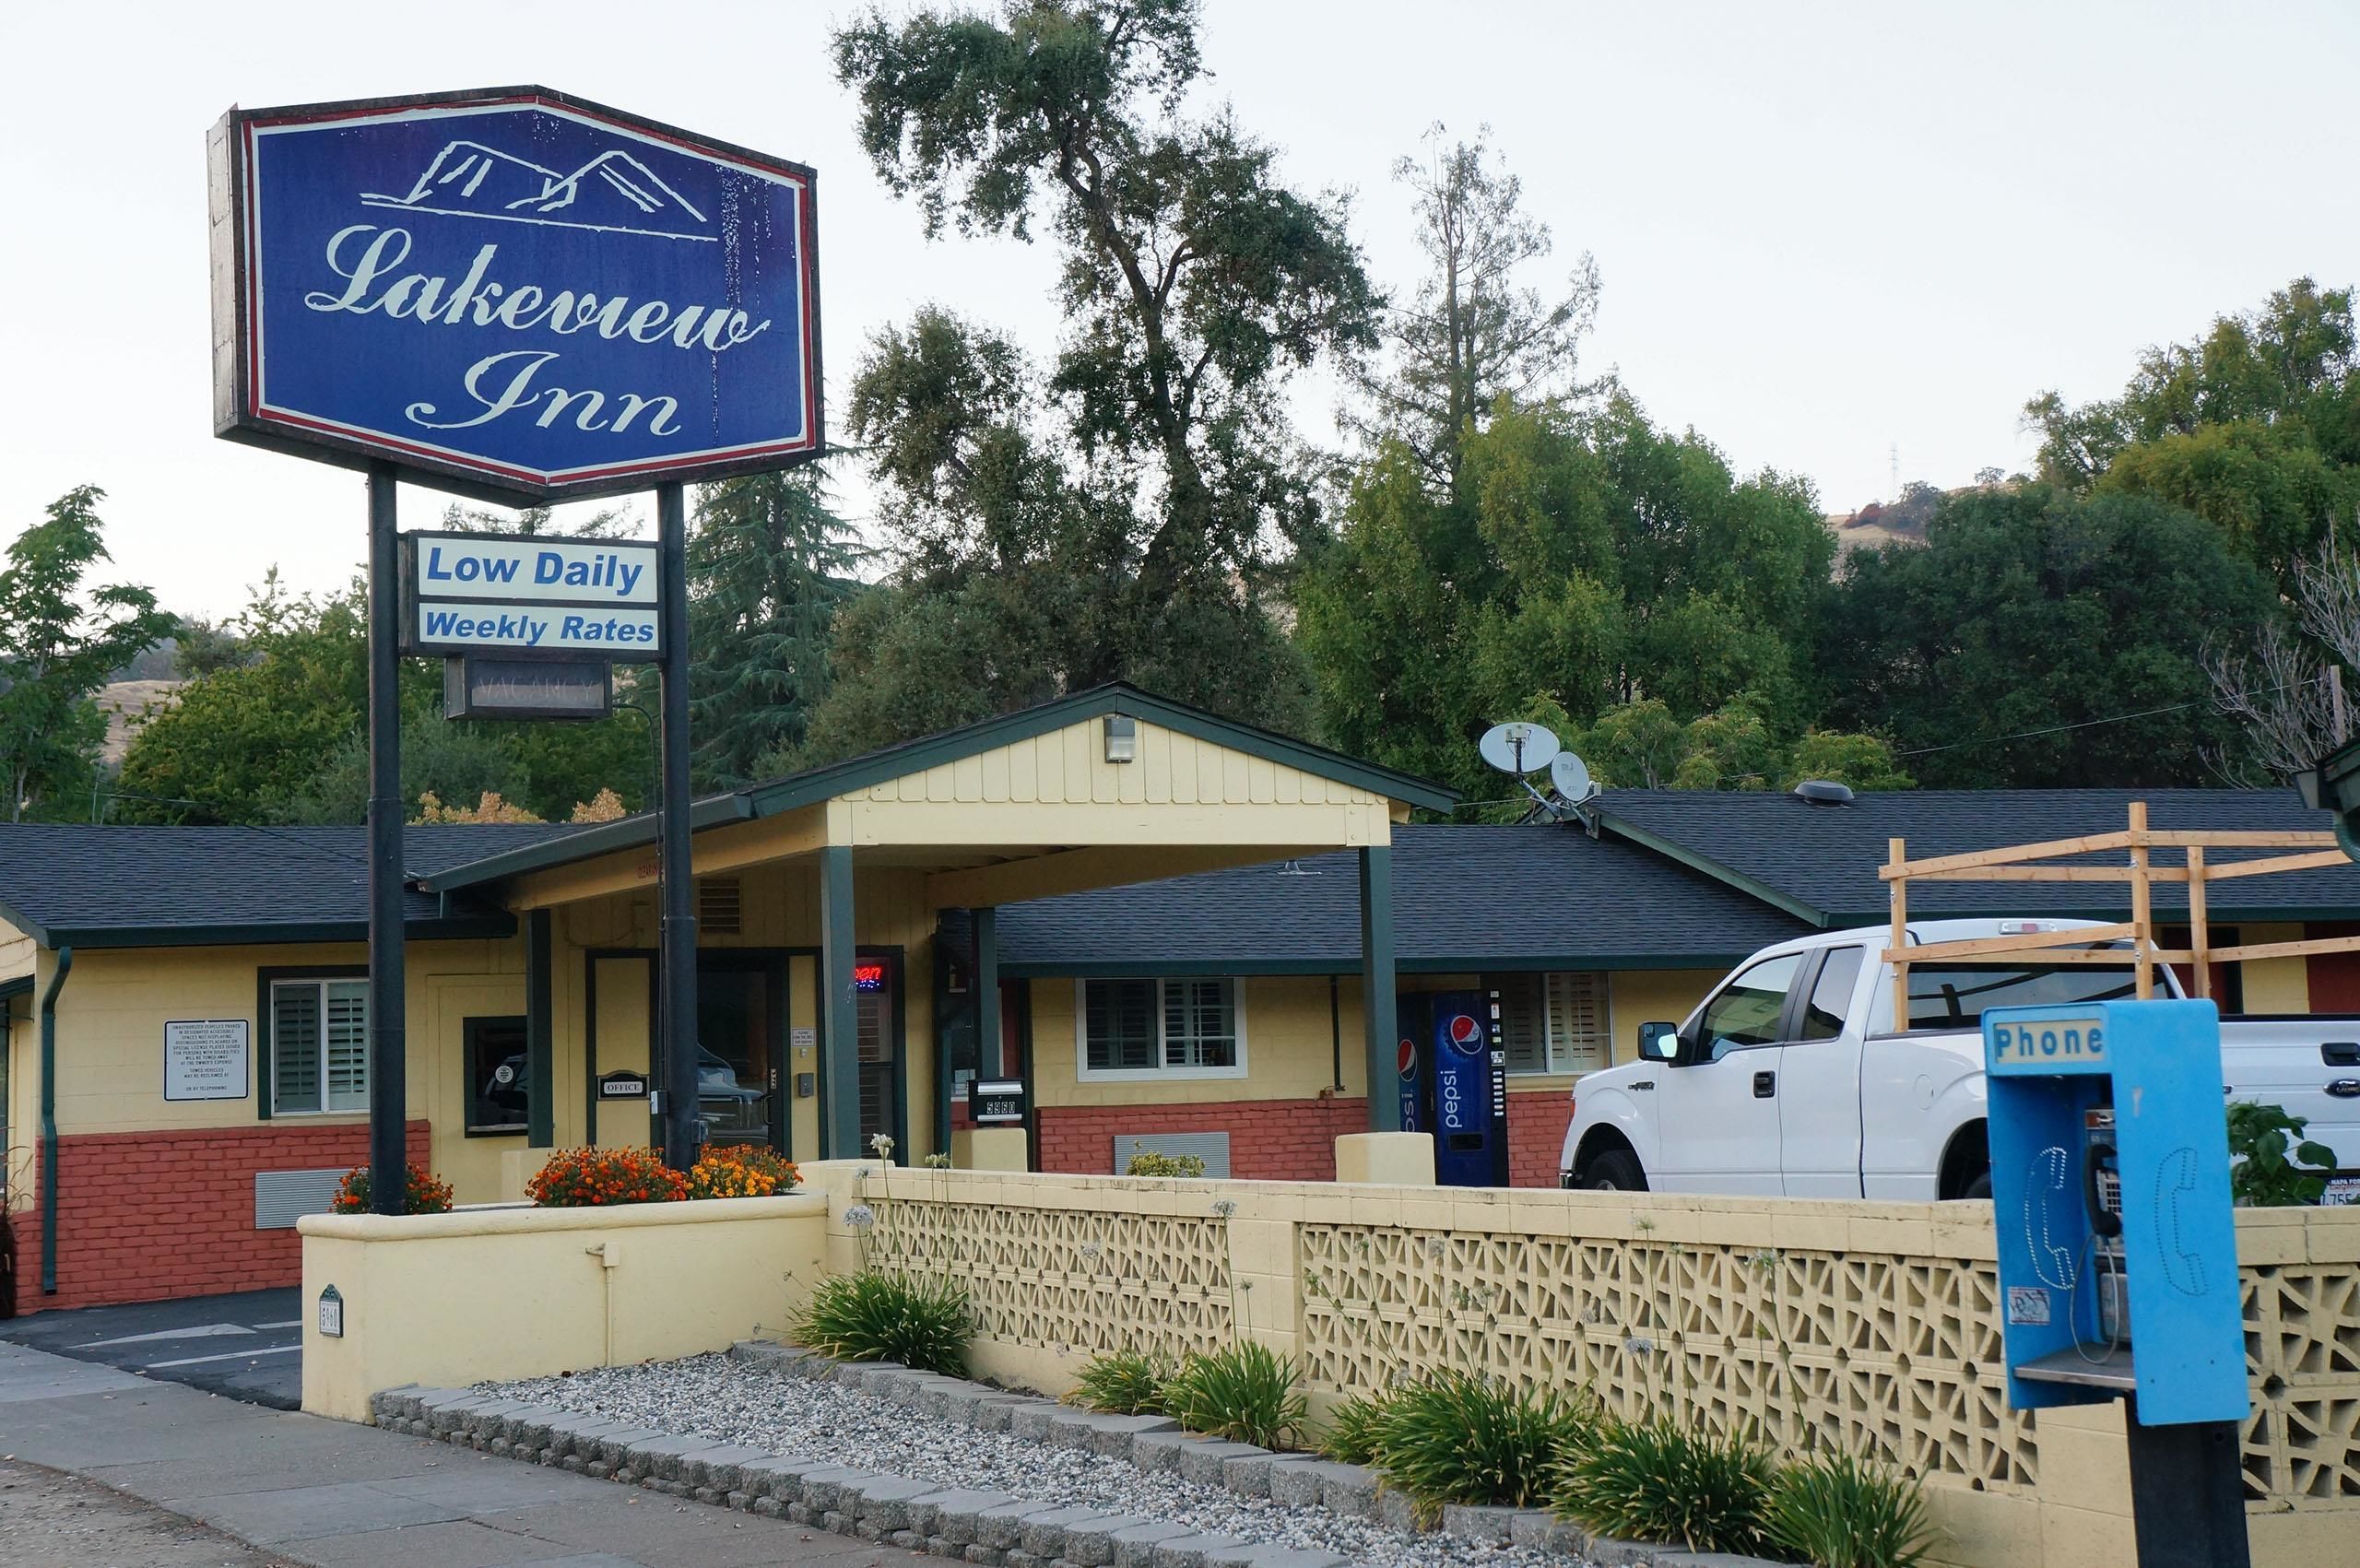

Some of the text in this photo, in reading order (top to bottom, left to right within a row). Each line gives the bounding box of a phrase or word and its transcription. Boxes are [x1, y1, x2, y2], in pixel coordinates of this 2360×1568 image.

[304, 225, 771, 351] Lakeview
[406, 351, 681, 436] Inn
[427, 548, 643, 595] Low Daily
[426, 611, 654, 645] Weekly Rates
[1994, 1025, 2103, 1058] Phone
[607, 1083, 640, 1091] OFFICE
[1440, 1070, 1462, 1128] pepsi
[986, 1102, 1015, 1114] 5960
[322, 1307, 338, 1328] 5960
